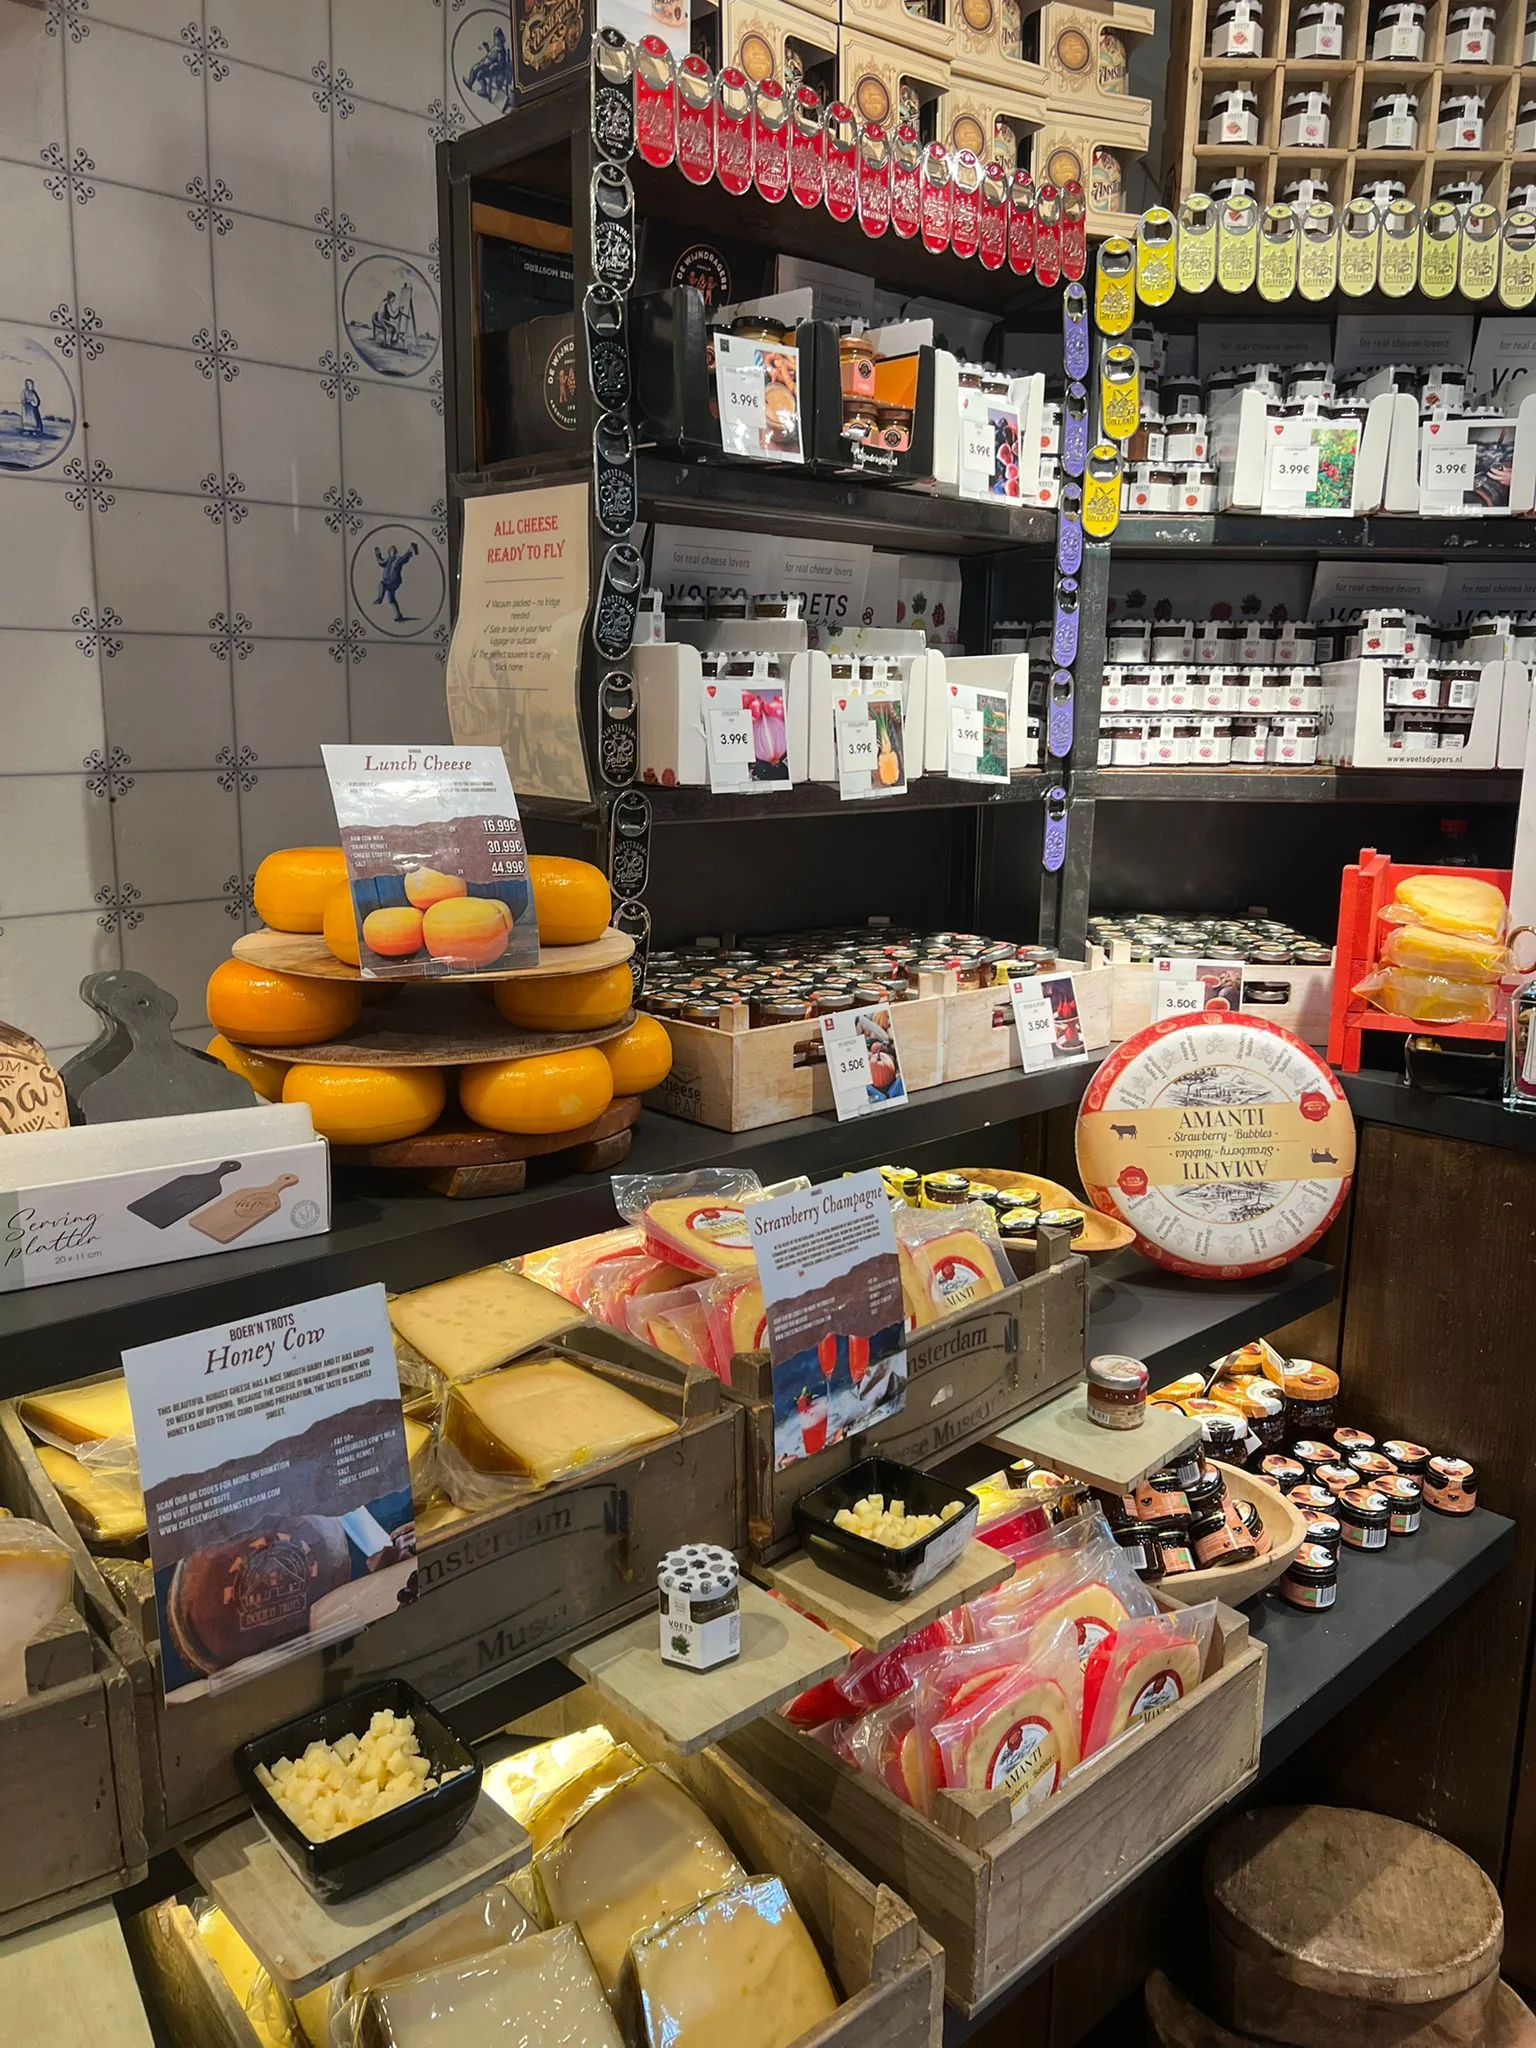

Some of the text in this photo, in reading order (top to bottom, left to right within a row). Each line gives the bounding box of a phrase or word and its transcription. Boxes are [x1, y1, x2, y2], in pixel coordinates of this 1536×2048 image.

[730, 391, 760, 409] 3.99€
[969, 442, 991, 459] 3.99€
[1278, 464, 1310, 475] 3.99€
[1434, 463, 1467, 475] 3.99€
[494, 515, 558, 537] ALL CHEESE
[487, 539, 566, 563] READY TO FLY
[672, 552, 750, 570] for real cheese lovers
[784, 561, 852, 578] for real cheese lovers
[1348, 583, 1363, 592] real
[492, 600, 511, 608] Vacuum
[513, 599, 531, 608] packed
[545, 596, 560, 608] fridge
[489, 625, 501, 633] Safe
[508, 625, 519, 633] take
[525, 626, 537, 634] your
[720, 733, 748, 745] 3.99€
[957, 728, 978, 741] 3.99€
[848, 742, 872, 755] 3.99€
[364, 755, 472, 771] Lunch Cheese
[1387, 755, 1463, 764] www.voetsdippers.nl
[482, 819, 517, 833] 16.99€
[487, 840, 523, 854] 30.99€
[491, 860, 525, 874] 44.99€
[1165, 997, 1197, 1009] 3.50€
[1028, 1019, 1050, 1031] 3.50€
[840, 1058, 864, 1073] 3.50€
[1178, 1107, 1265, 1129] AMANTI
[1173, 1129, 1272, 1142] Strawberry Bubbles
[1175, 1146, 1273, 1160] Strawberry Bubbles
[1183, 1158, 1268, 1180] AMANTI
[754, 1186, 883, 1236] Strawberry Champagne
[5, 1207, 104, 1242] Serving
[5, 1228, 102, 1267] platter
[55, 1256, 66, 1264] 20
[944, 1290, 975, 1309] MANTI
[229, 1313, 295, 1342] BOER'N TROTS
[204, 1326, 325, 1375] Honey Cow
[907, 1327, 987, 1376] msterdam
[158, 1405, 172, 1416] THIS
[173, 1396, 204, 1412] BEAUTIFUL
[205, 1389, 228, 1402] ROBUST
[229, 1383, 251, 1396] CHEESE
[252, 1379, 263, 1389] HAS
[269, 1374, 281, 1384] NICE
[283, 1367, 305, 1380] SMOOTH
[306, 1362, 322, 1374] DAIRY
[323, 1359, 334, 1369] AND
[341, 1354, 352, 1364] HAS
[166, 1417, 175, 1426] 20
[175, 1410, 196, 1424] WEEKS
[237, 1391, 261, 1405] BECAUSE
[263, 1387, 273, 1397] THE
[274, 1380, 295, 1394] CHEESE
[303, 1371, 325, 1385] WASHED
[326, 1367, 339, 1378] WITH
[341, 1362, 358, 1374] HONEY
[359, 1358, 370, 1368] AND
[167, 1426, 187, 1439] HONEY
[196, 1417, 215, 1430] ADDED
[225, 1411, 236, 1421] THE
[237, 1406, 252, 1418] CURD
[254, 1400, 274, 1413] DURING
[314, 1385, 324, 1395] THE
[325, 1380, 341, 1392] TASTE
[349, 1371, 372, 1385] SLIGHTLY
[333, 1435, 343, 1446] FAT
[384, 1431, 396, 1442] MILK
[336, 1453, 358, 1466] ANIMAL
[337, 1466, 350, 1476] SALT
[156, 1498, 174, 1512] SCAN
[175, 1493, 187, 1506] OUR
[198, 1483, 219, 1498] CODES
[220, 1479, 231, 1491] FOR
[232, 1473, 249, 1487] MORE
[250, 1459, 290, 1481] INFORMATION
[338, 1474, 358, 1487] CHEESE
[158, 1492, 231, 1525] AND VISIT OUR WEBSITE
[159, 1487, 281, 1536] WWW.CHEESEMUSEUMAMSTERDAM.COM
[419, 1505, 573, 1589] msterdam
[668, 1619, 693, 1632] VOETS
[1004, 1747, 1042, 1789] AMANTI
